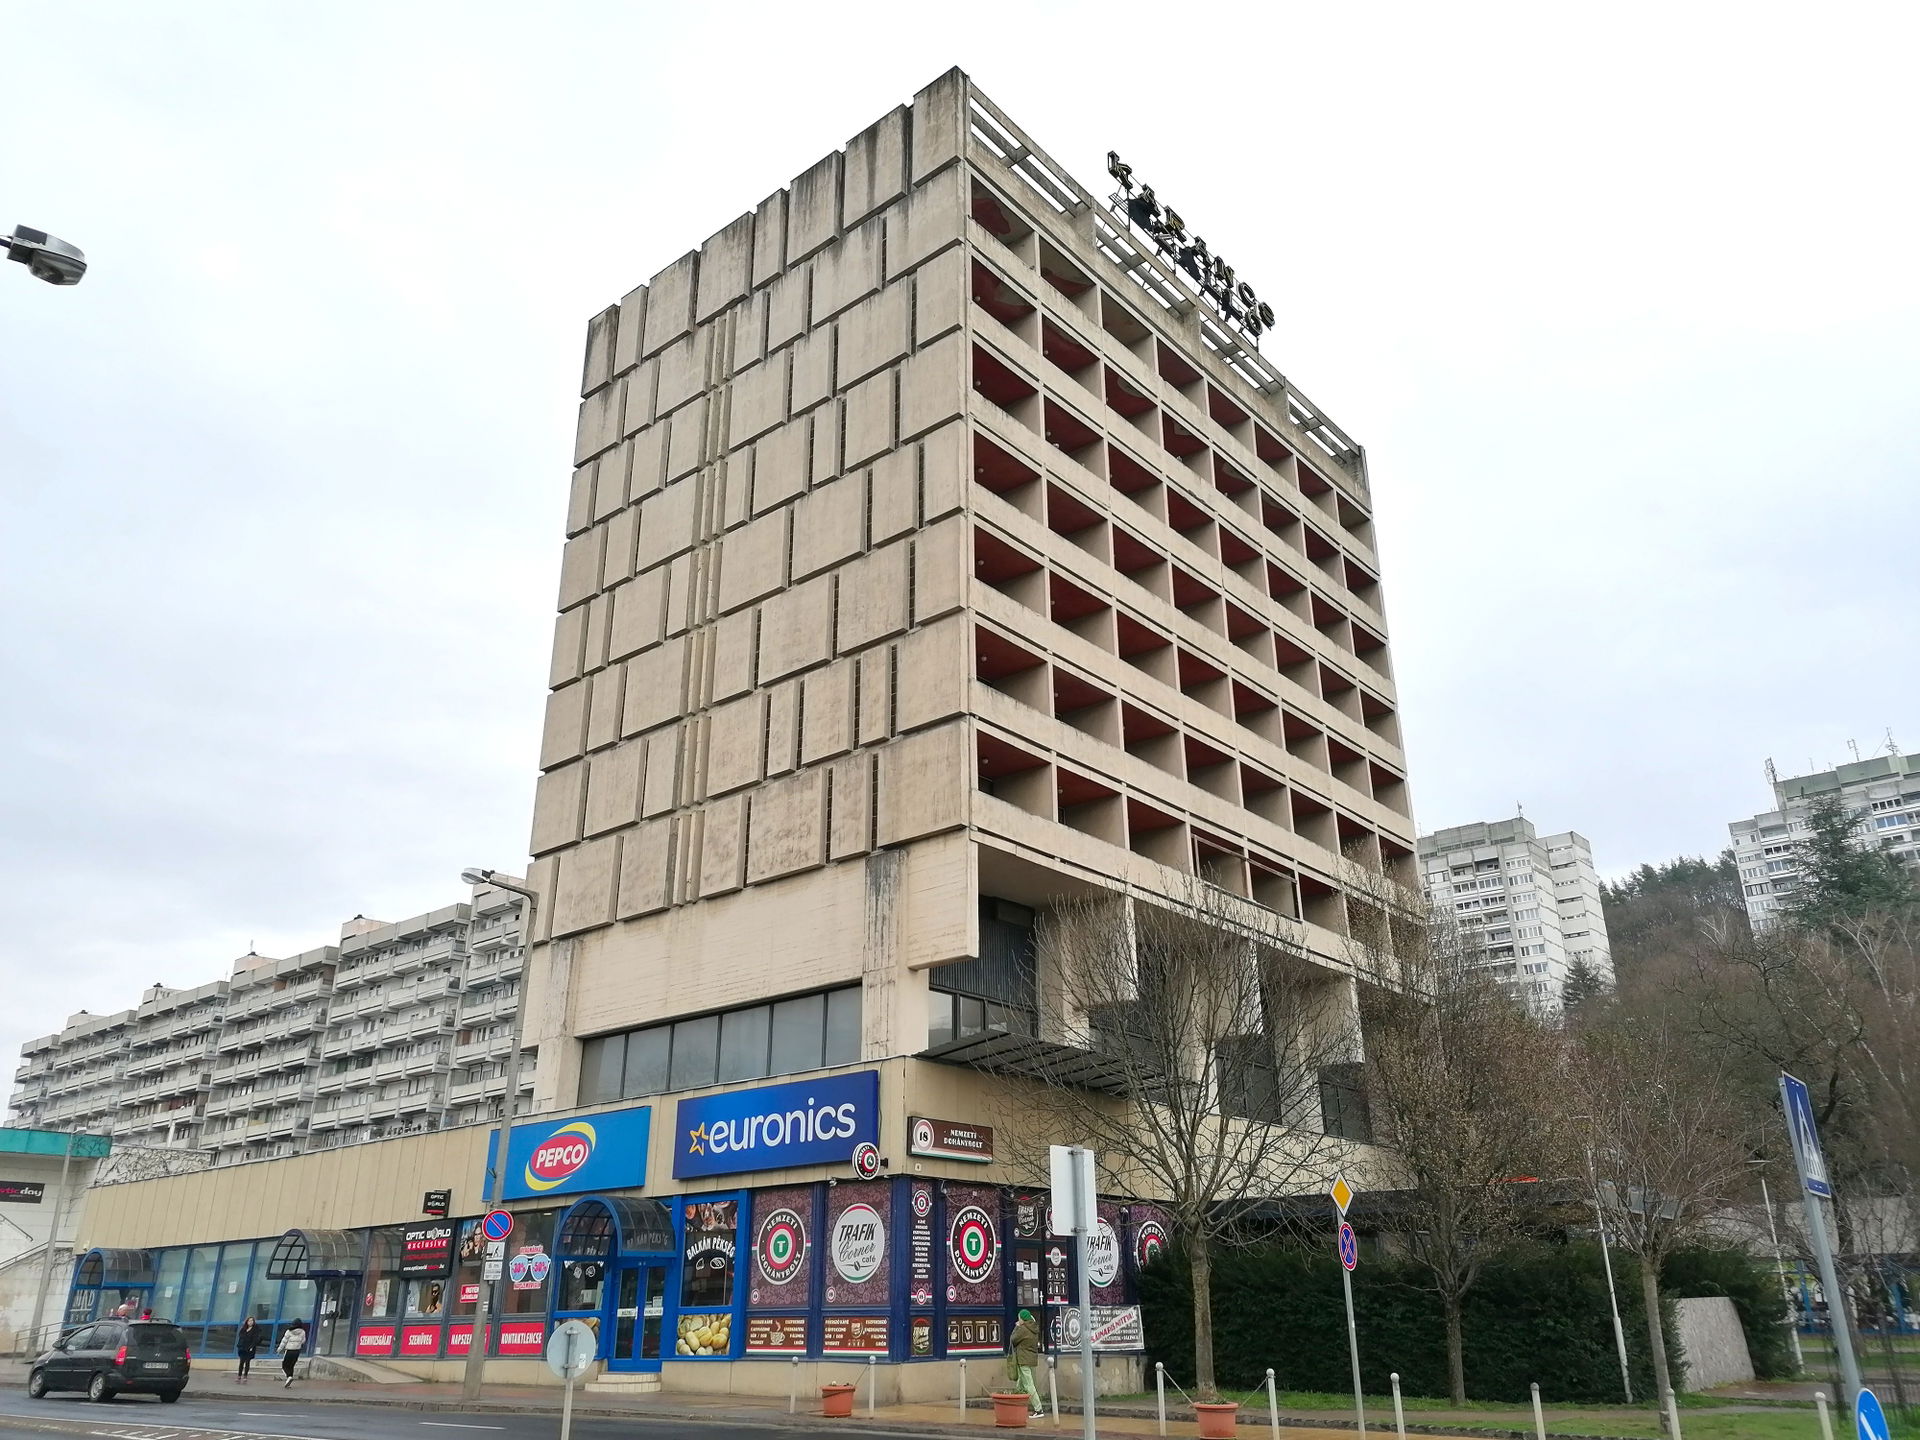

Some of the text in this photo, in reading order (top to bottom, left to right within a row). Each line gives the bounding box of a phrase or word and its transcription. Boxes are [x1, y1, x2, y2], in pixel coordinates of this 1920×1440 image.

[709, 1097, 856, 1154] euronics
[919, 1131, 929, 1142] 18
[950, 1129, 977, 1139] NEMZETI
[943, 1137, 983, 1149] DOHÁNYBOLT
[536, 1144, 585, 1169] PEPCO
[766, 1214, 798, 1231] NEMZETI
[958, 1212, 988, 1228] NEMZETI
[406, 1230, 425, 1241] OPTIC
[838, 1223, 878, 1242] TRAFIK
[407, 1240, 447, 1250] exclusive
[686, 1235, 736, 1260] BALKÁN PÉKSÉG
[777, 1240, 786, 1253] T
[838, 1239, 877, 1263] Corner
[969, 1238, 978, 1251] T
[760, 1251, 801, 1279] DOHÁNYBOLT
[861, 1255, 877, 1263] café
[954, 1249, 993, 1277] DOHÁNYBOLT
[500, 1332, 543, 1345] KONTAKTLENCSE
